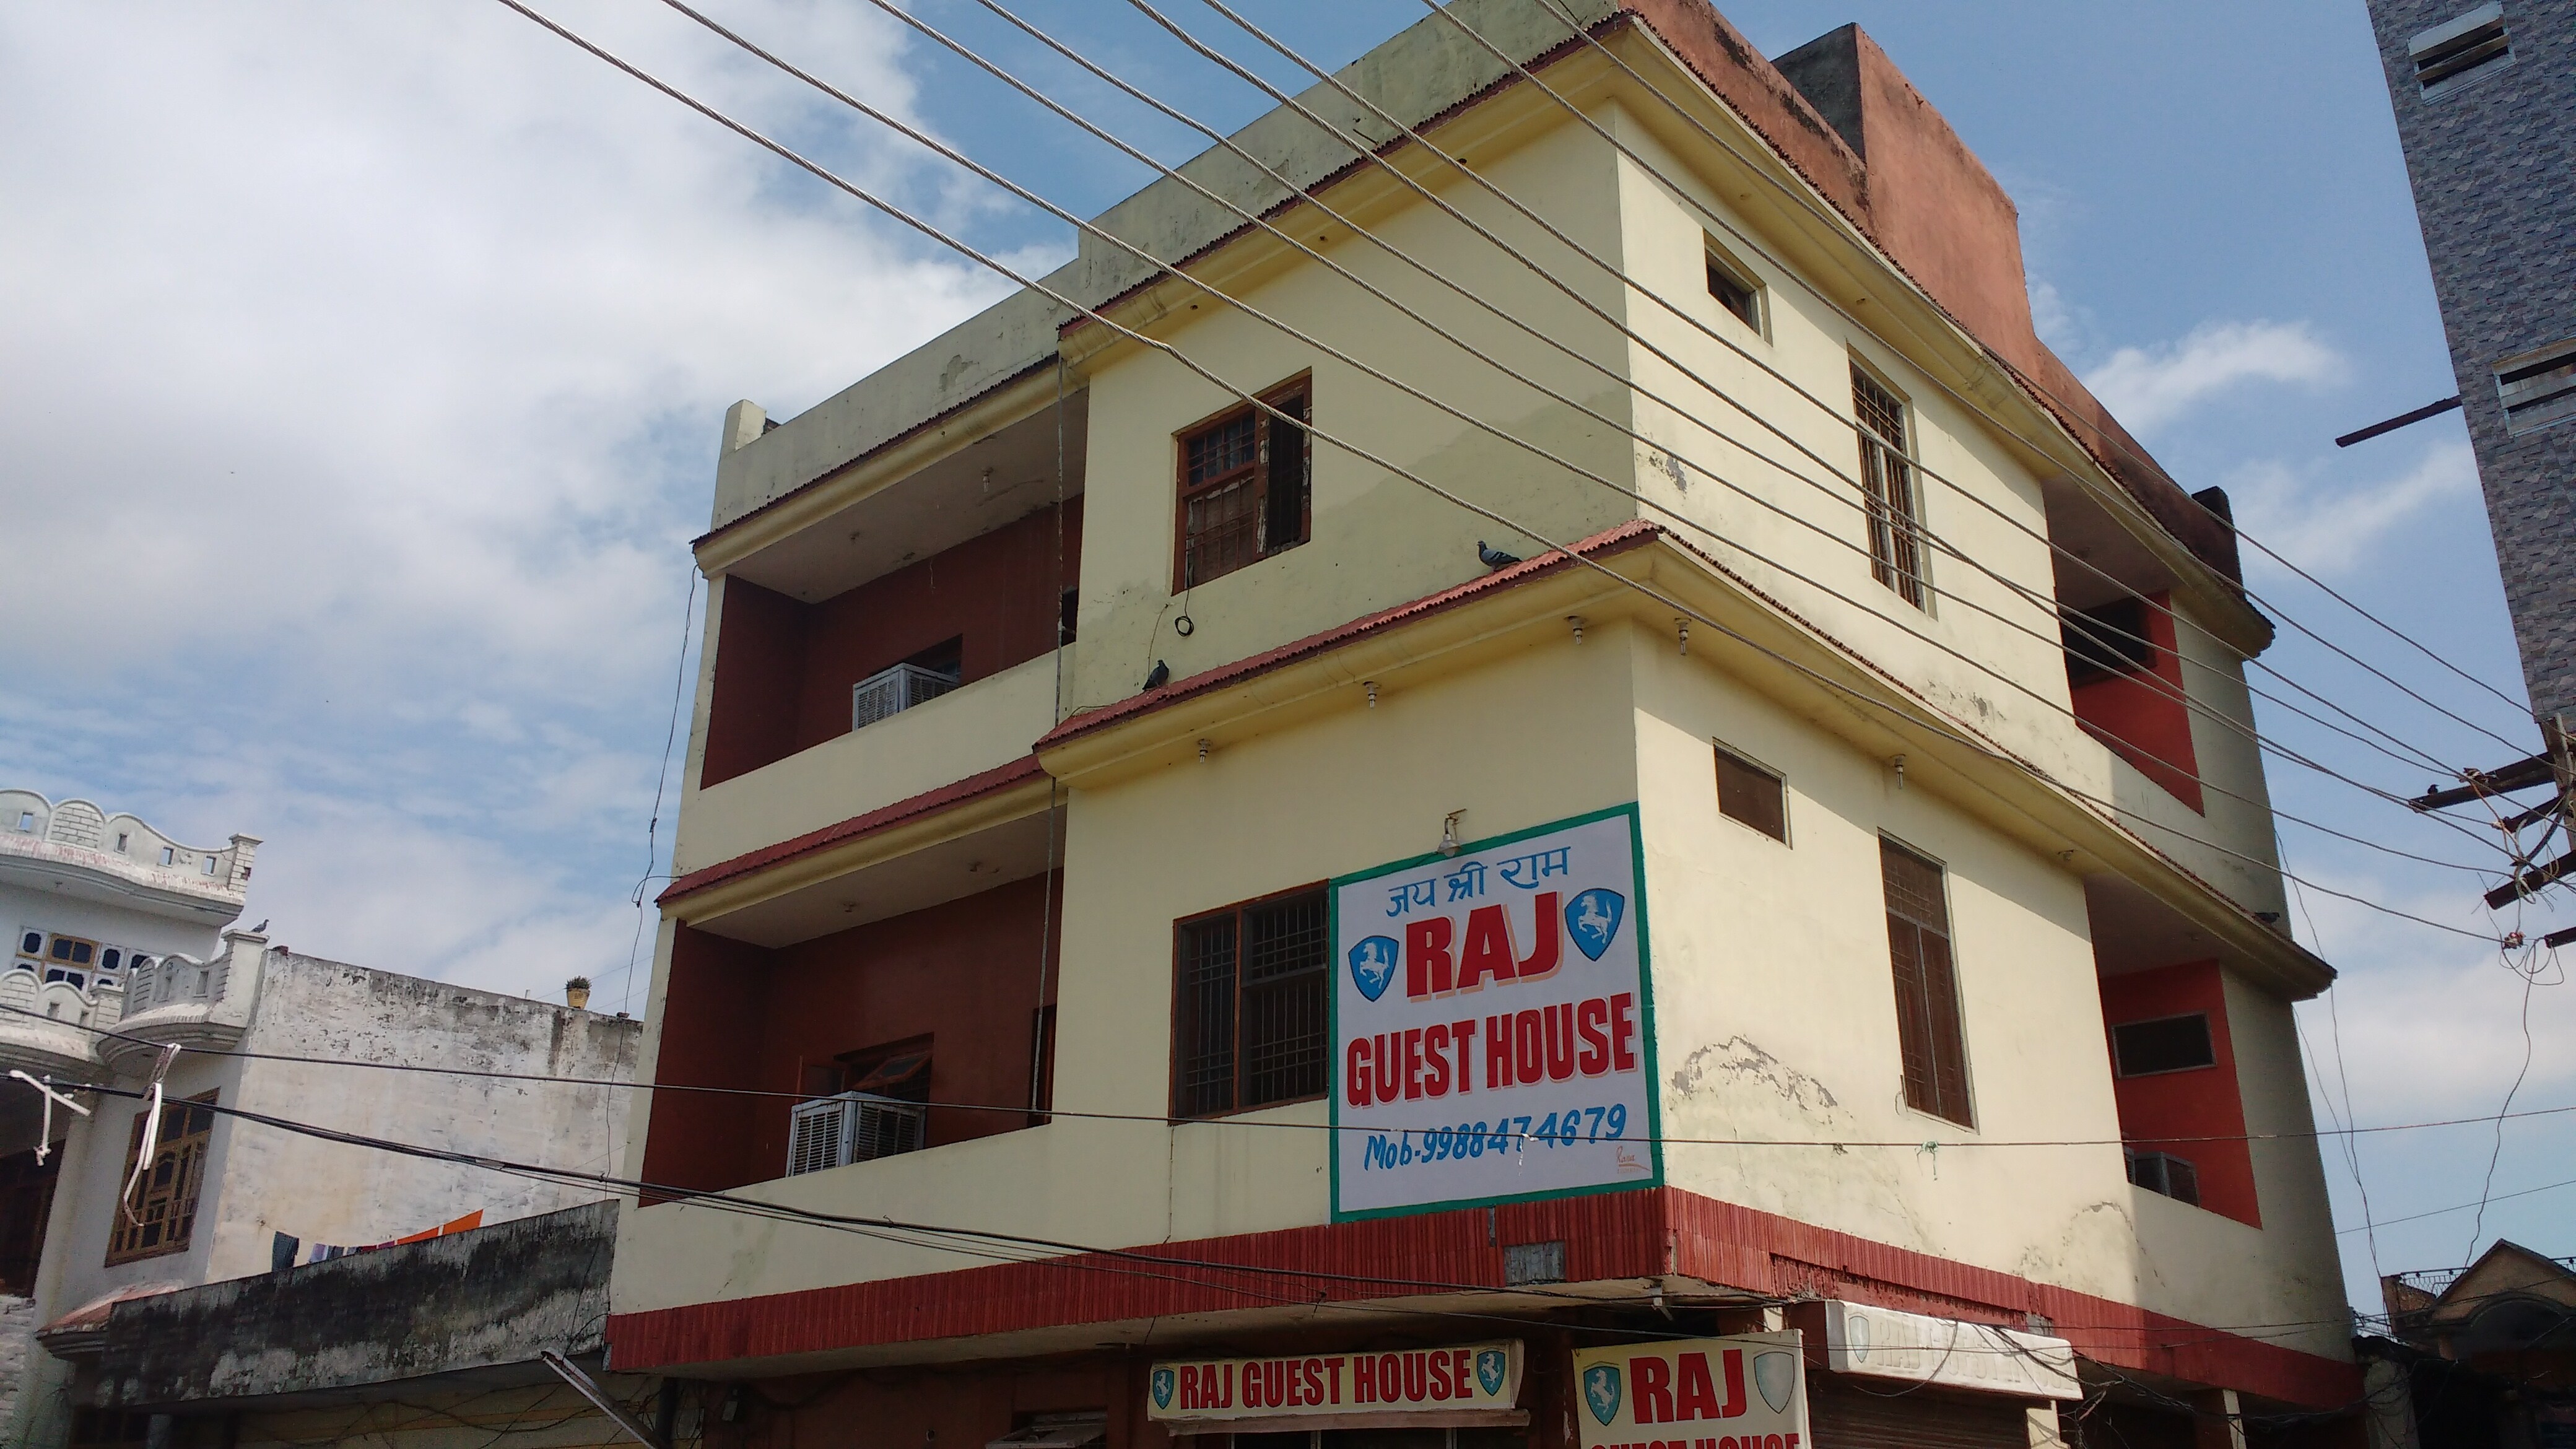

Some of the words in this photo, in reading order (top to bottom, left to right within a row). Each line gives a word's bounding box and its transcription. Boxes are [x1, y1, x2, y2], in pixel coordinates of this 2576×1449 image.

[1386, 878, 1436, 917] जय
[1443, 861, 1488, 902] श्री
[1497, 846, 1571, 889] राम
[1406, 891, 1562, 1001] RAJ
[1347, 1019, 1476, 1107] GUEST
[1486, 992, 1636, 1089] HOUSE
[1180, 1364, 1233, 1409] RAJ
[1242, 1357, 1344, 1408] GUEST
[1354, 1350, 1472, 1403] HOUSE
[1629, 1349, 1747, 1424] RAJ
